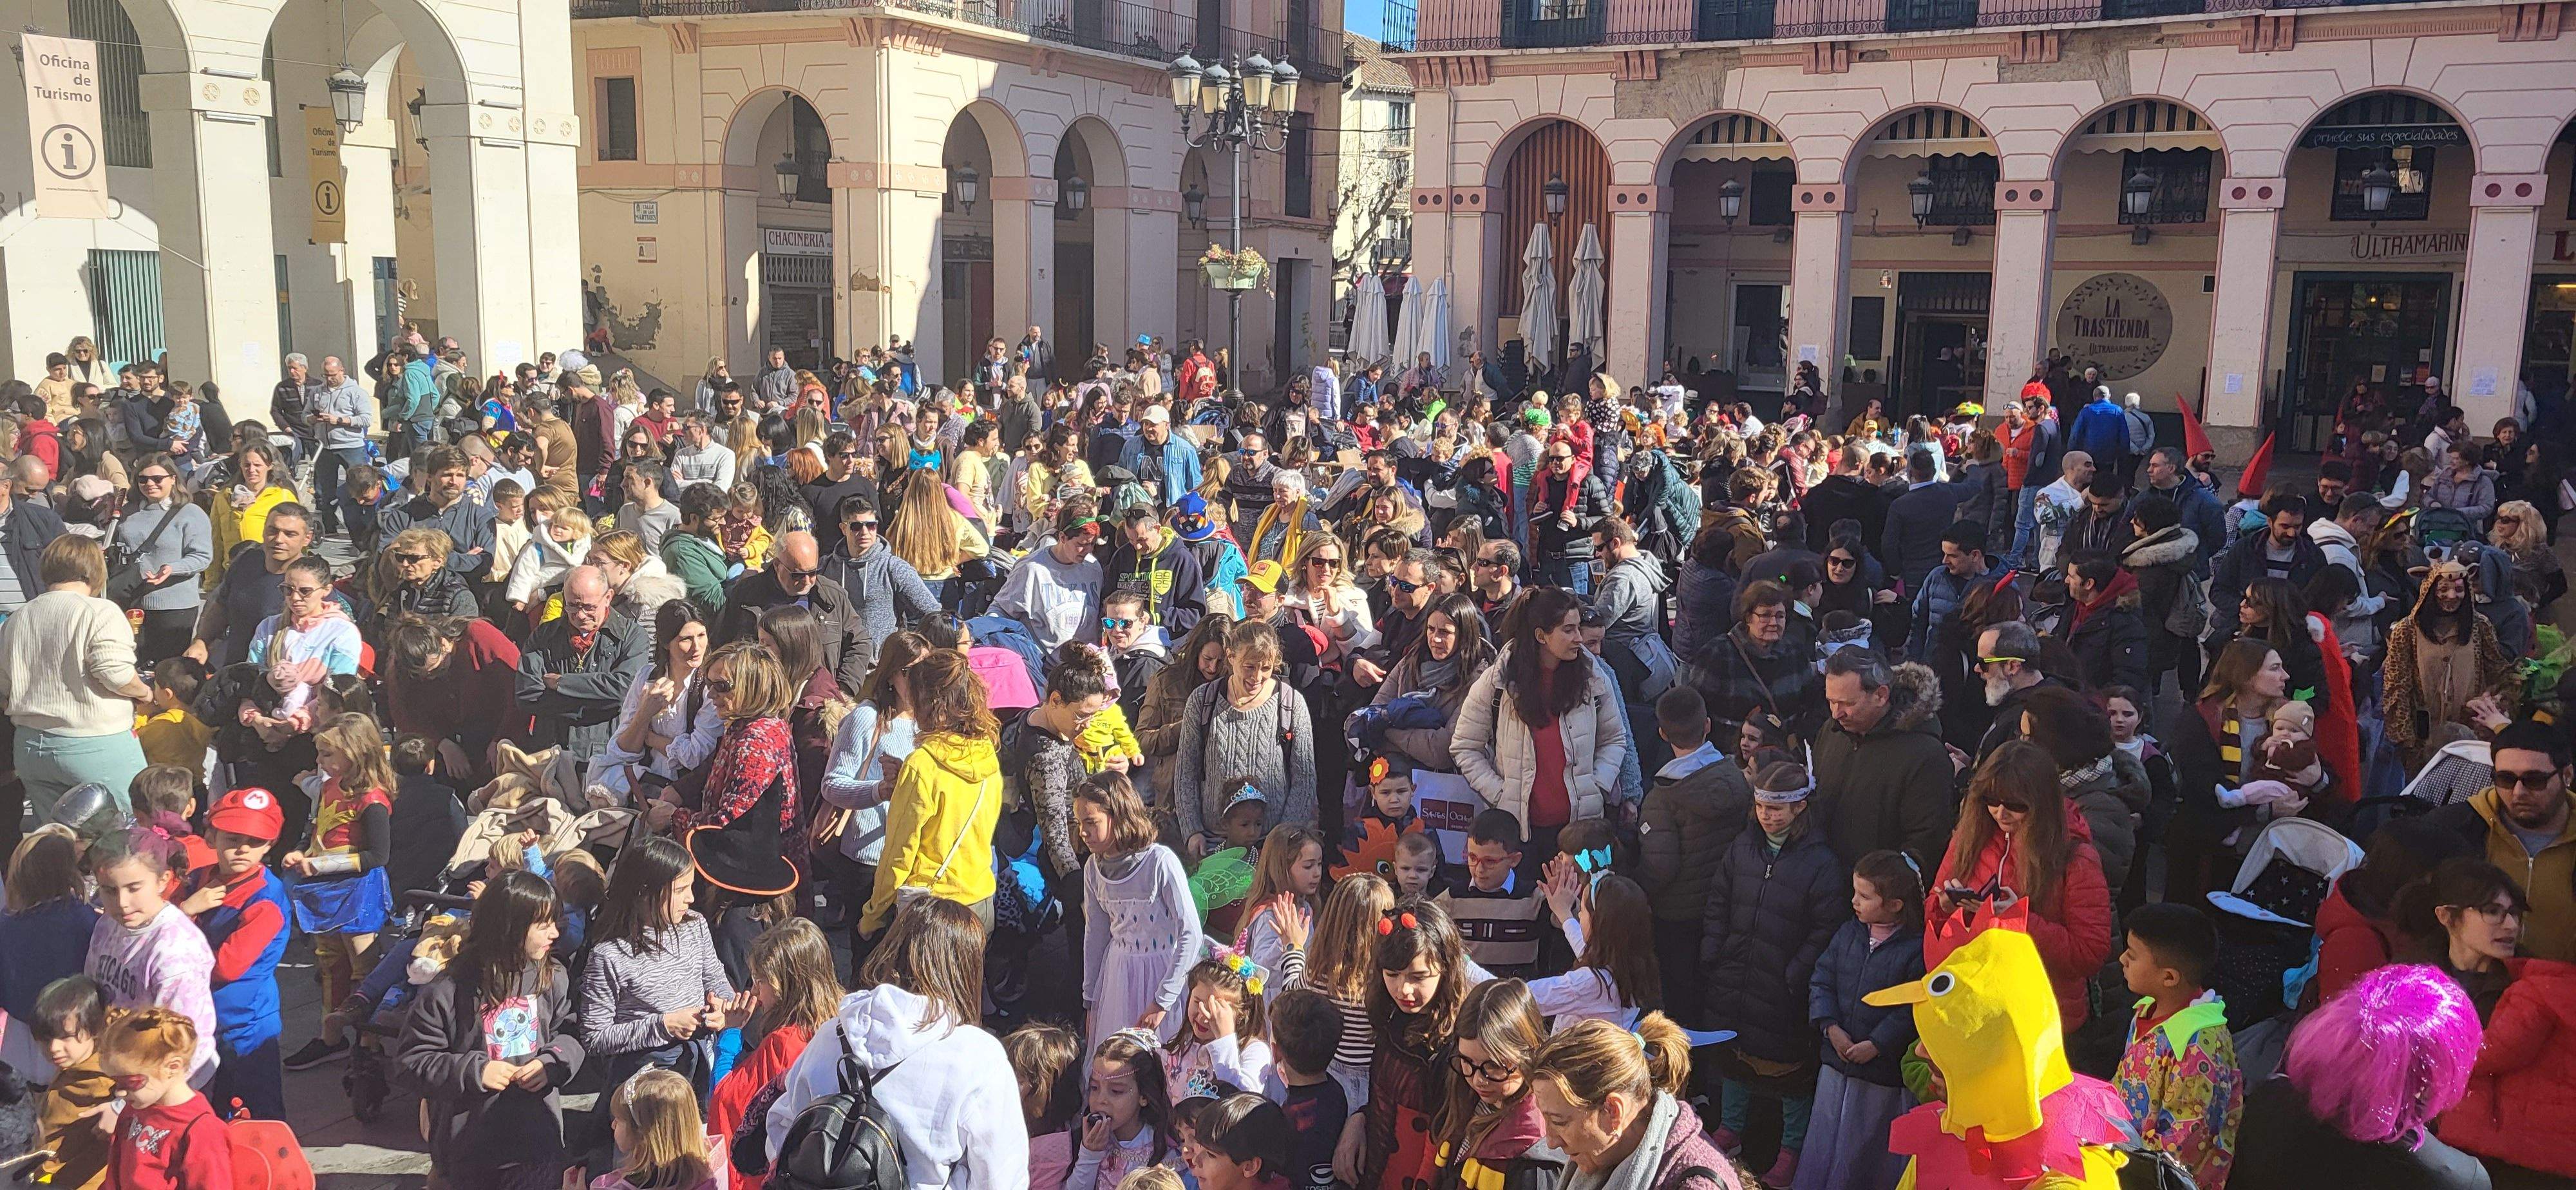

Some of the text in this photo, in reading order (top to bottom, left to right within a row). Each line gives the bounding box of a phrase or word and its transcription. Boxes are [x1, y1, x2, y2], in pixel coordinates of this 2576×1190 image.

[39, 54, 90, 70] Oficina
[73, 73, 91, 86] de
[33, 86, 92, 102] Turismo
[312, 128, 334, 136] Oficina
[2313, 128, 2458, 146] pruebe sus especialidades
[311, 148, 336, 156] Turismo
[768, 231, 825, 248] CHACINERIA
[2355, 233, 2469, 258] ULTRAMARIN
[2105, 296, 2121, 318] LA
[2074, 315, 2150, 339] TRASTIENDA
